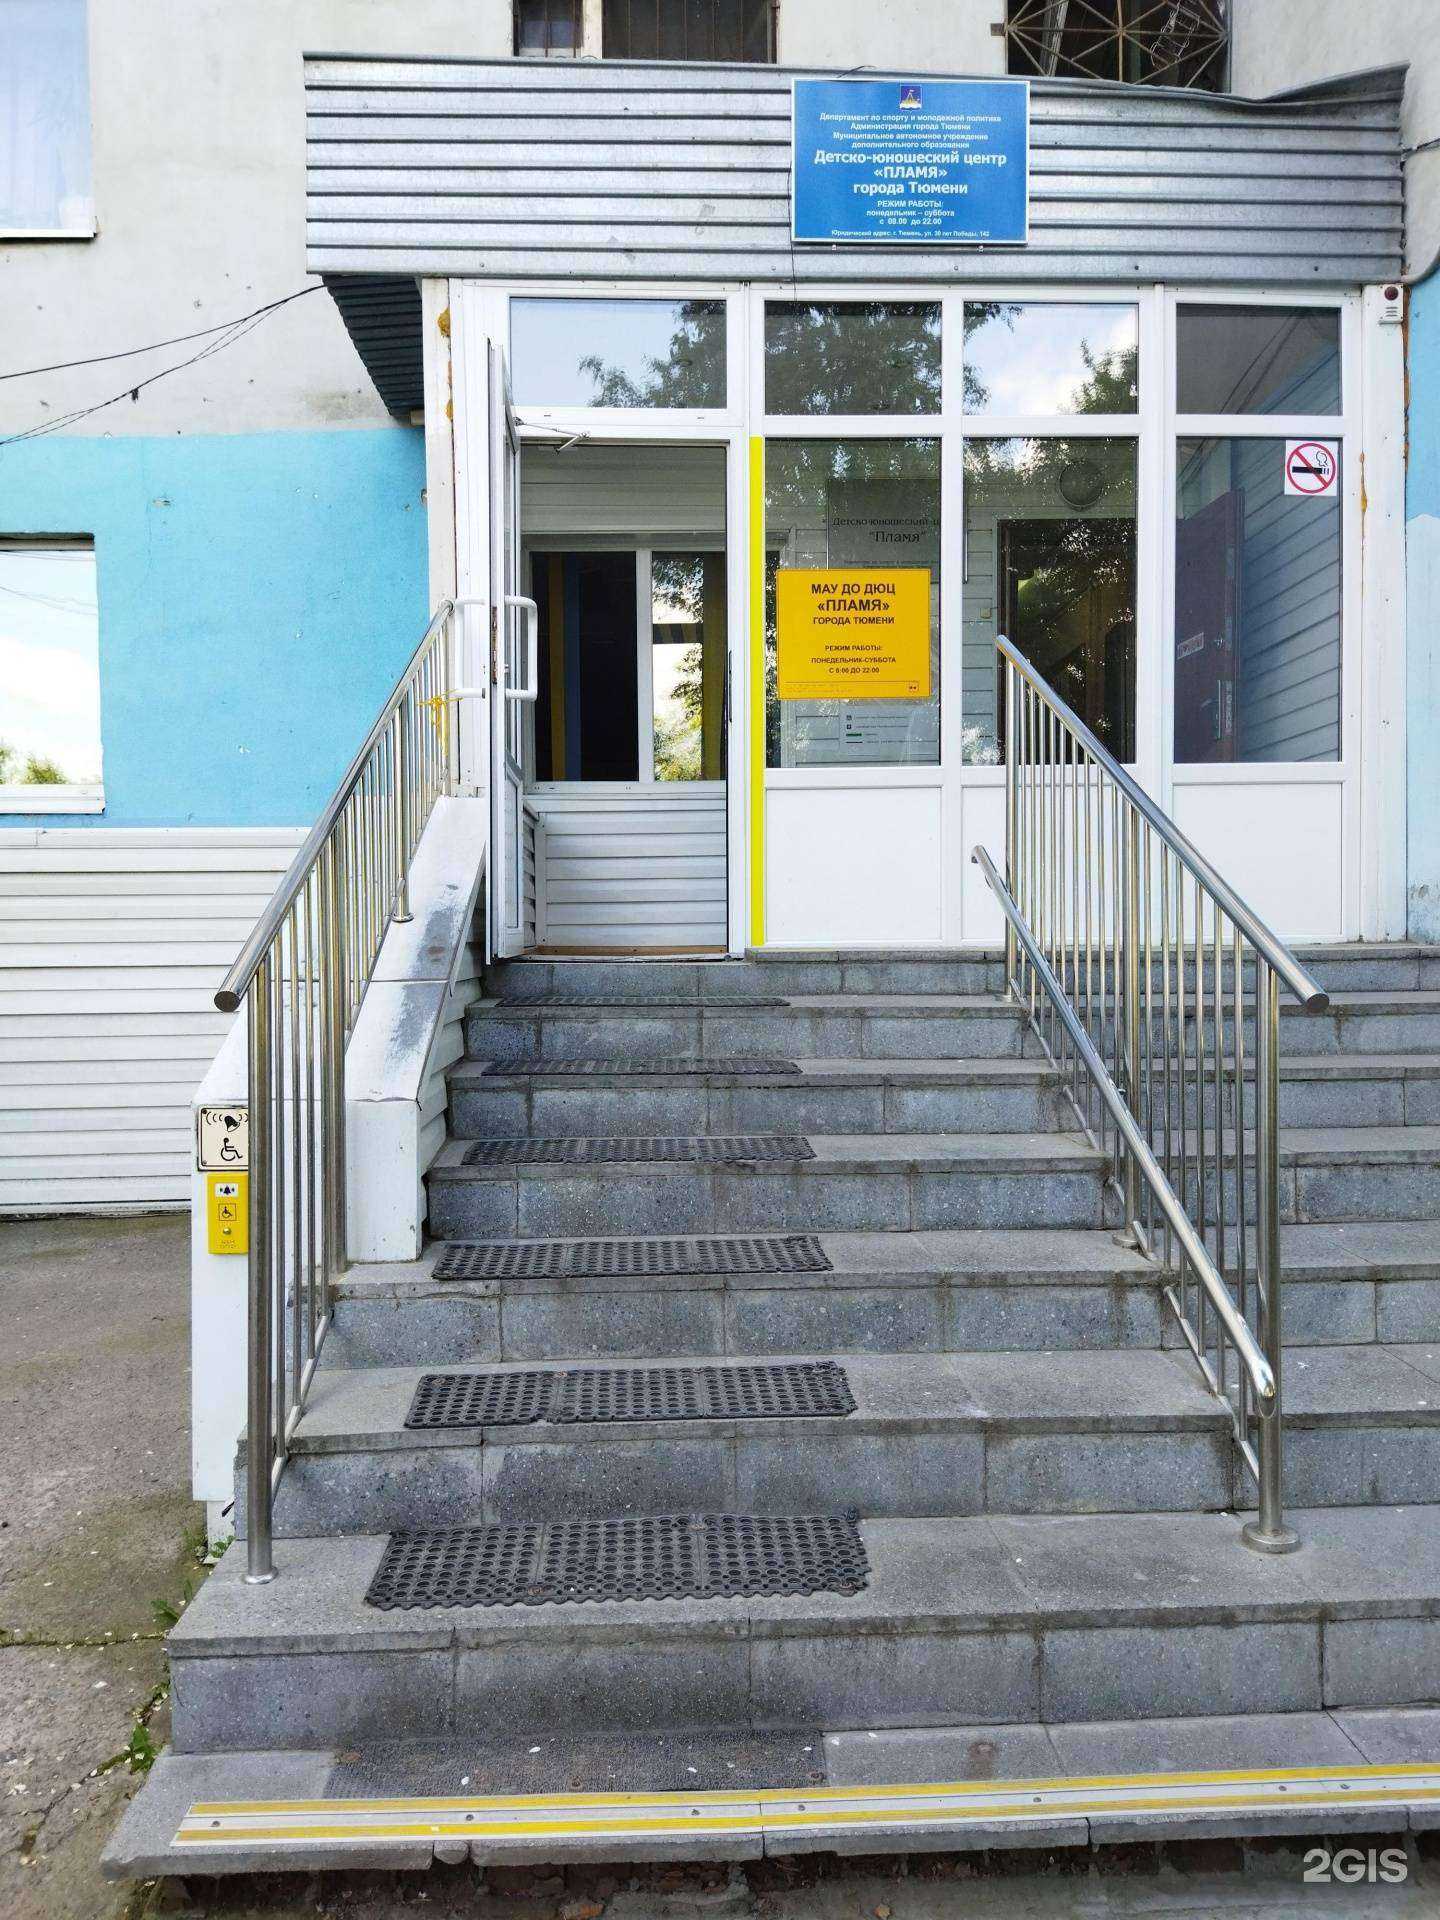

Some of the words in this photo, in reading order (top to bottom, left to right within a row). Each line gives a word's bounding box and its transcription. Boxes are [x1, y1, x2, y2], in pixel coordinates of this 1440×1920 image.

[820, 113, 869, 122] Департамент
[940, 122, 971, 130] Тюмени
[833, 132, 894, 140] Муниципальное
[942, 134, 988, 142] учреждение
[920, 141, 970, 150] образования
[814, 150, 959, 164] Детско-юношеский
[964, 154, 1006, 166] центр
[874, 166, 948, 178] «ПЛАМЯ»
[853, 183, 904, 196] города
[908, 182, 968, 194] Тюмени
[877, 200, 906, 208] РЕЖИМ
[924, 210, 955, 218] суббота
[811, 584, 838, 594] МАУ
[842, 584, 860, 596] ДО
[864, 584, 896, 596] ДЮЦ
[818, 600, 890, 612] «ПЛАМЯ»
[813, 617, 851, 626] ГОРОДА
